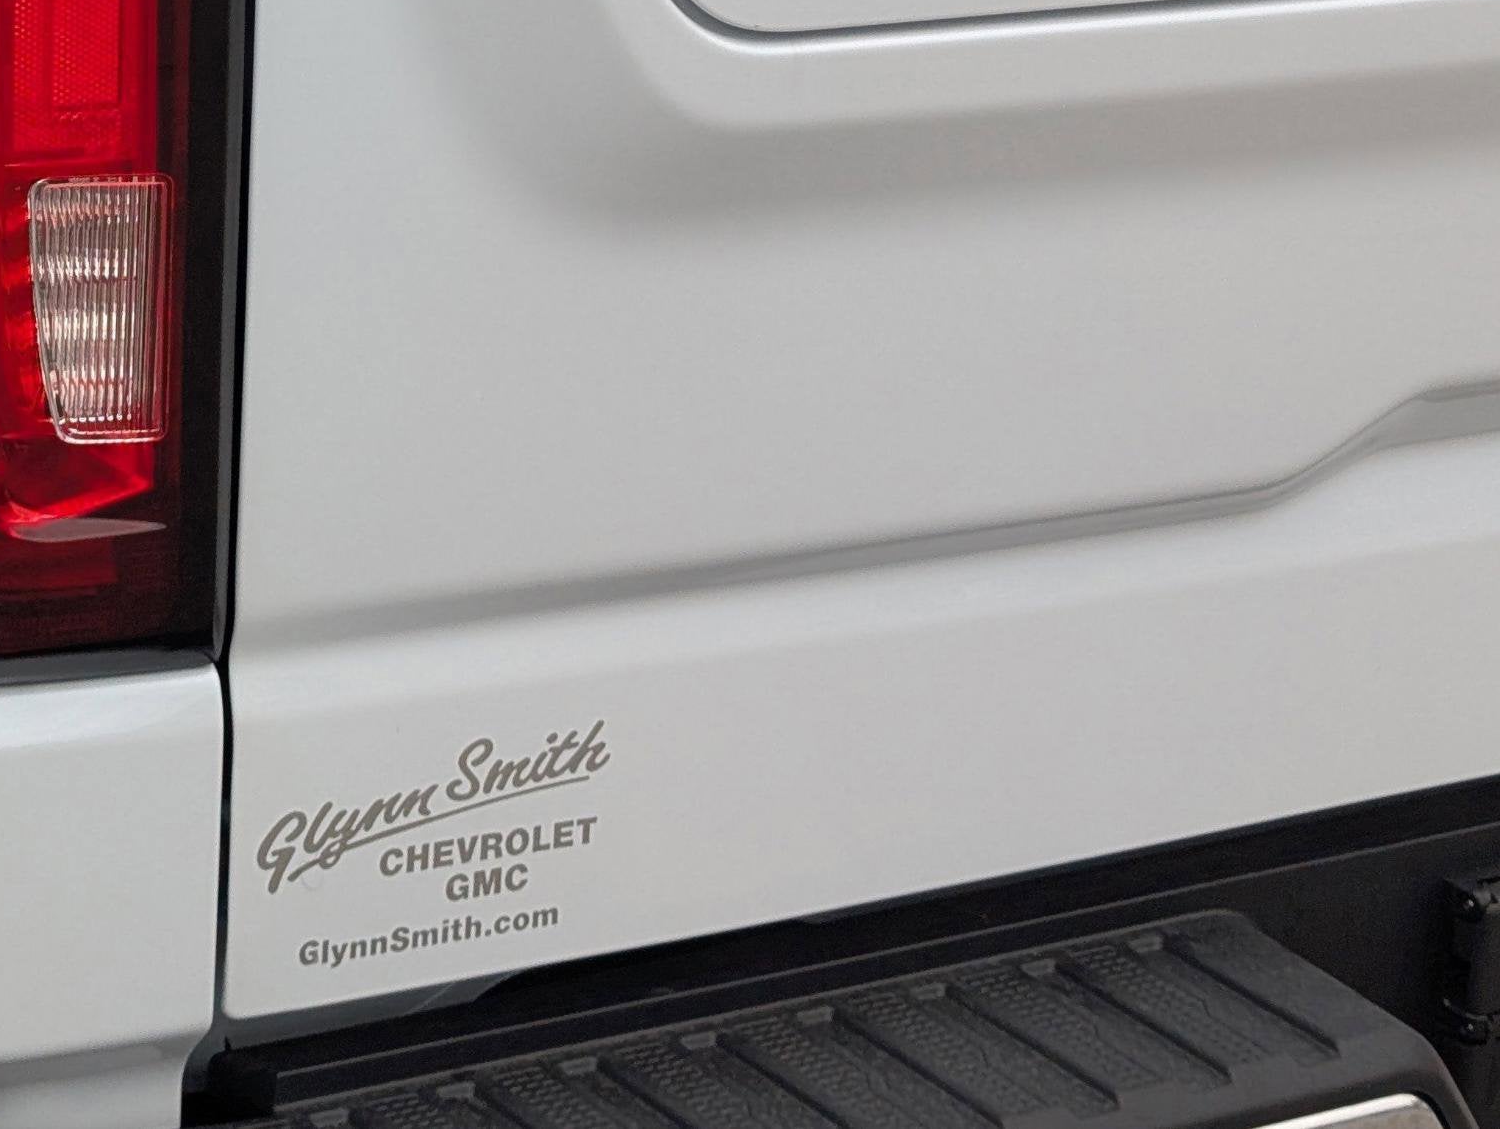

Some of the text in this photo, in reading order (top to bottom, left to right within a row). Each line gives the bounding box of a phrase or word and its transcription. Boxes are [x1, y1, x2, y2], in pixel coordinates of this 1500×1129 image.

[256, 719, 612, 894] Glynn Smith
[378, 816, 599, 877] CHEVROLET
[445, 863, 529, 902] GMC
[298, 905, 560, 969] GlynnSmith.com
